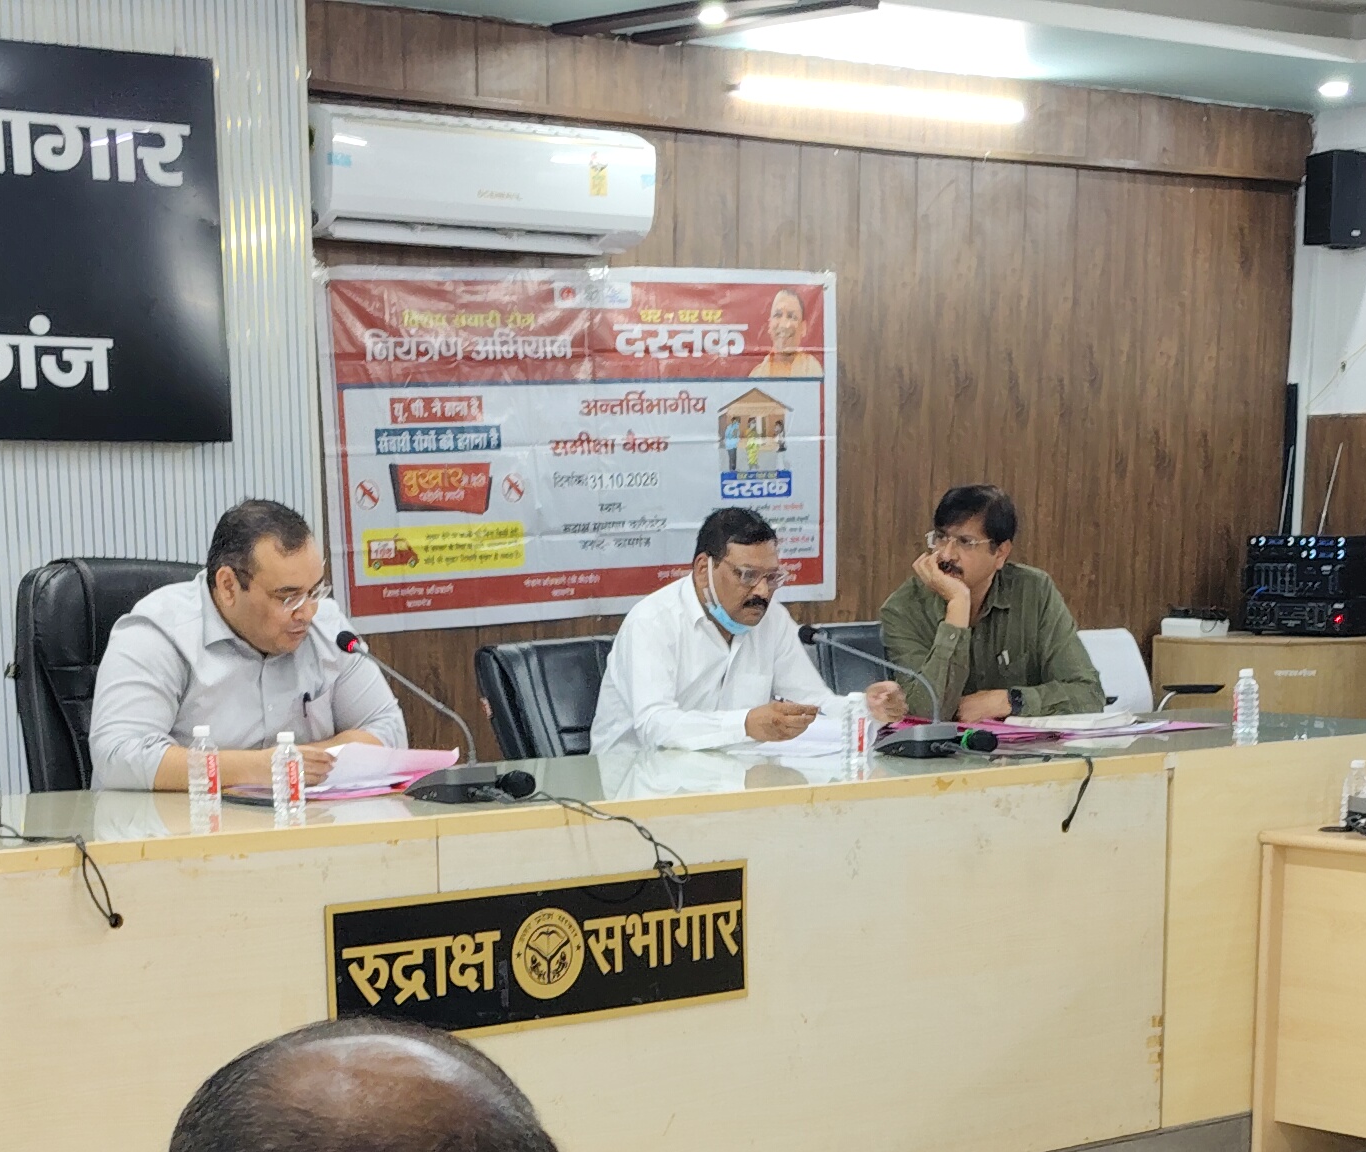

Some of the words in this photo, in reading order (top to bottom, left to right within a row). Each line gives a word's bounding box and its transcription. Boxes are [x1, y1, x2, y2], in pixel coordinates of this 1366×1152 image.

[365, 328, 463, 362] नियंत्रण
[471, 327, 572, 360] अभियान
[613, 323, 748, 358] दस्तक
[579, 390, 707, 416] अन्तर्विभागीय
[549, 430, 616, 456] समीक्षा
[622, 429, 670, 454] बैठक
[402, 467, 463, 497] बुखार
[722, 477, 790, 497] दस्तक
[342, 930, 501, 1006] रुद्राक्ष
[584, 900, 742, 976] सभागार
